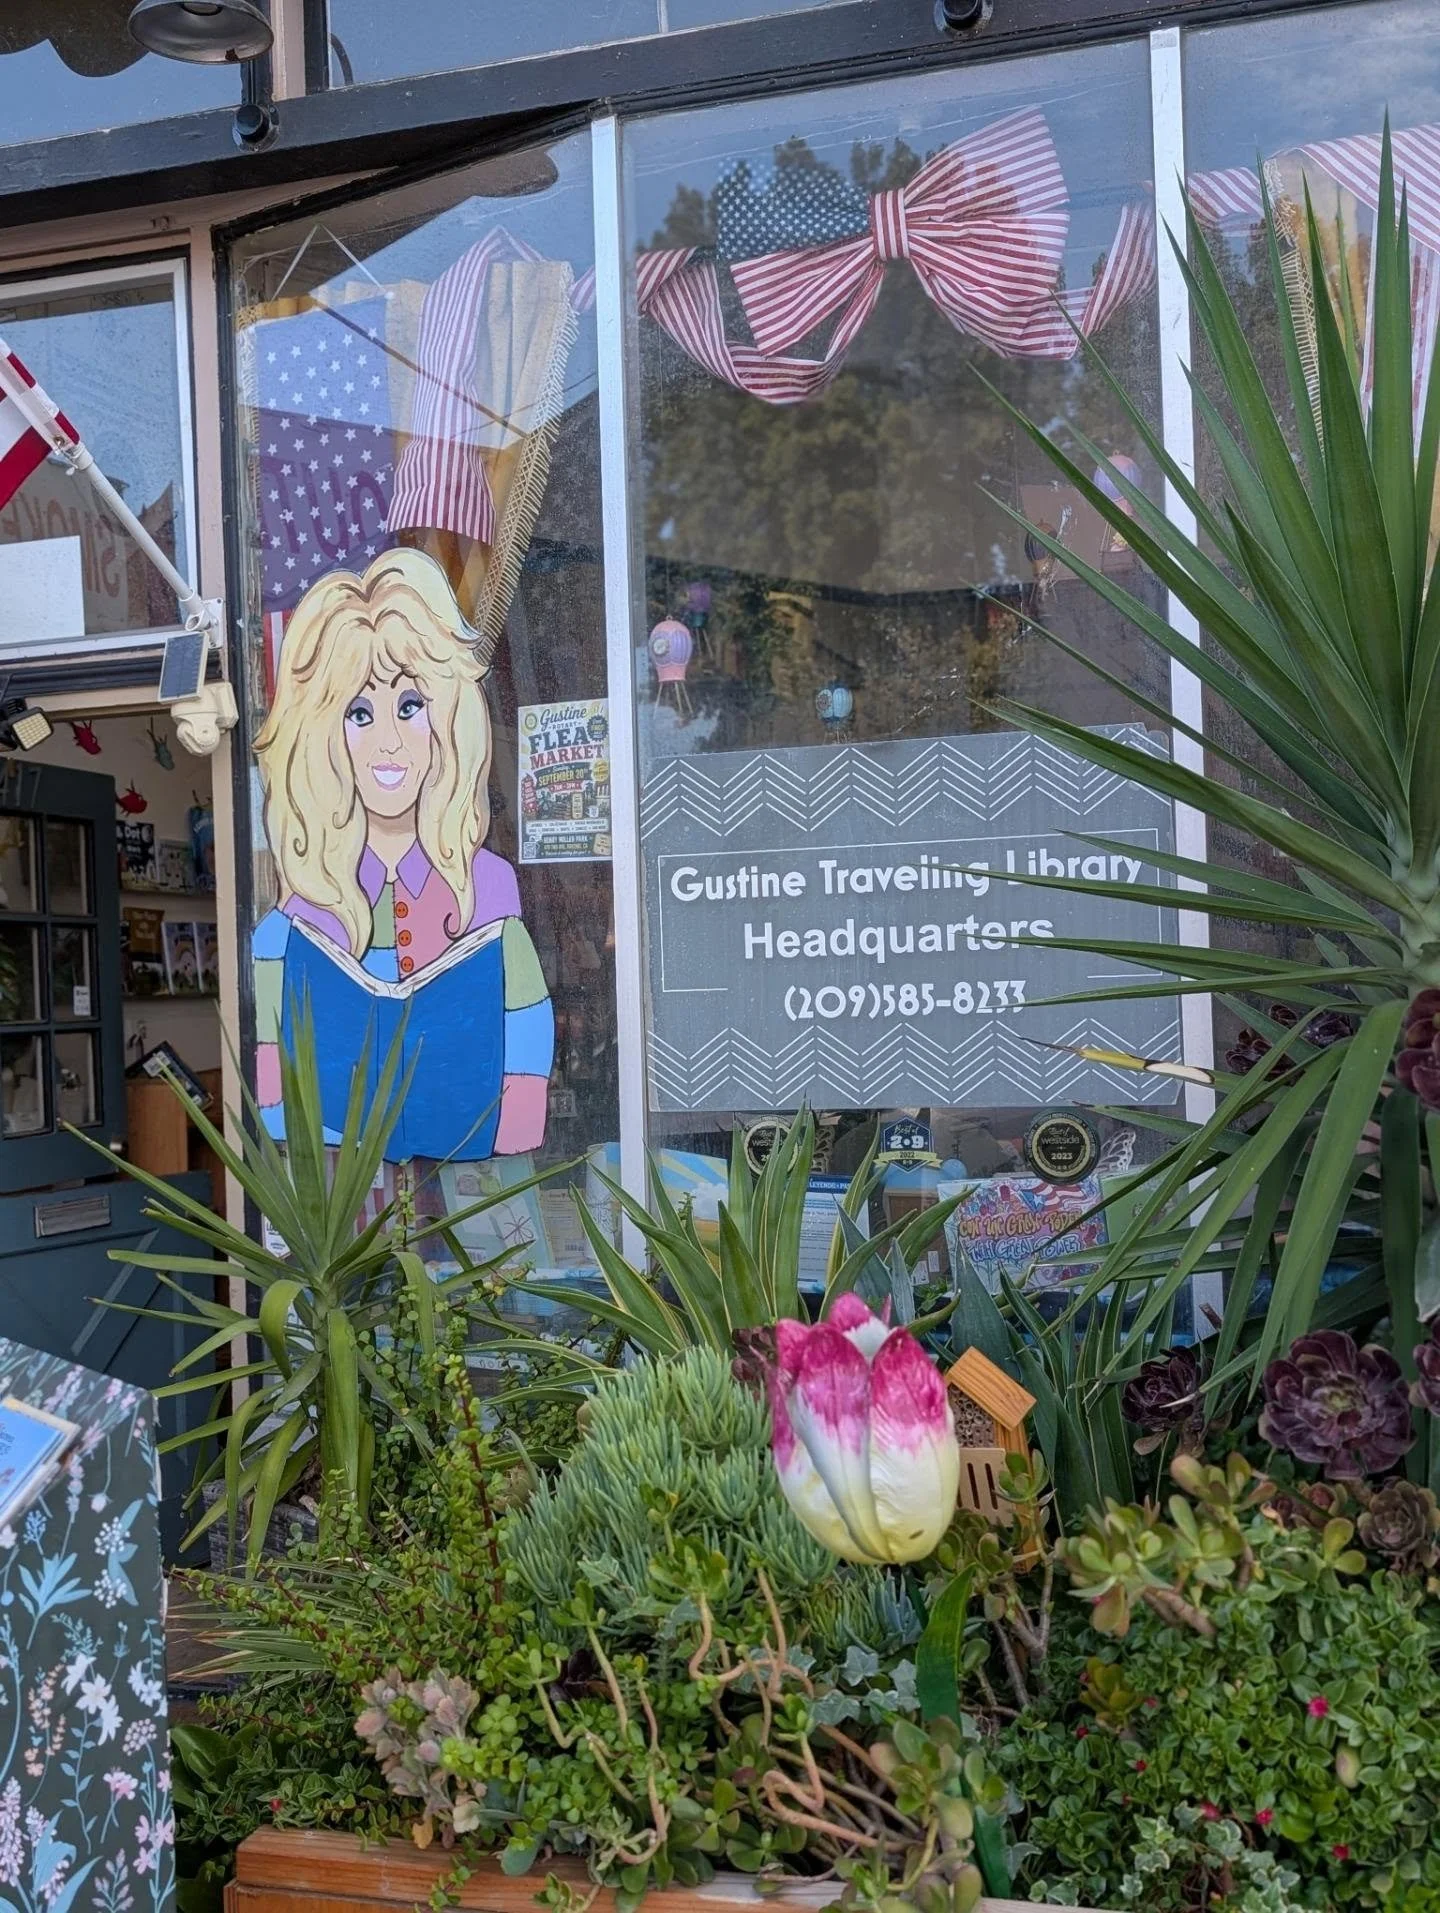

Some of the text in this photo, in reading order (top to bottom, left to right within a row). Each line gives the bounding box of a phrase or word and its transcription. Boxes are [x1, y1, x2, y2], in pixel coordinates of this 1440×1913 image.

[540, 706, 587, 732] Gustine
[528, 726, 590, 754] FLEA
[529, 744, 605, 771] MARKET
[538, 770, 574, 786] SEPTEMBER
[670, 848, 1142, 902] Gustine Traveling Library
[744, 915, 1055, 964] Headquarters
[784, 980, 1026, 1023] (209)585-8233
[894, 1124, 920, 1135] Best of
[1051, 1152, 1073, 1160] 2023
[1005, 1212, 1042, 1236] GRAN
